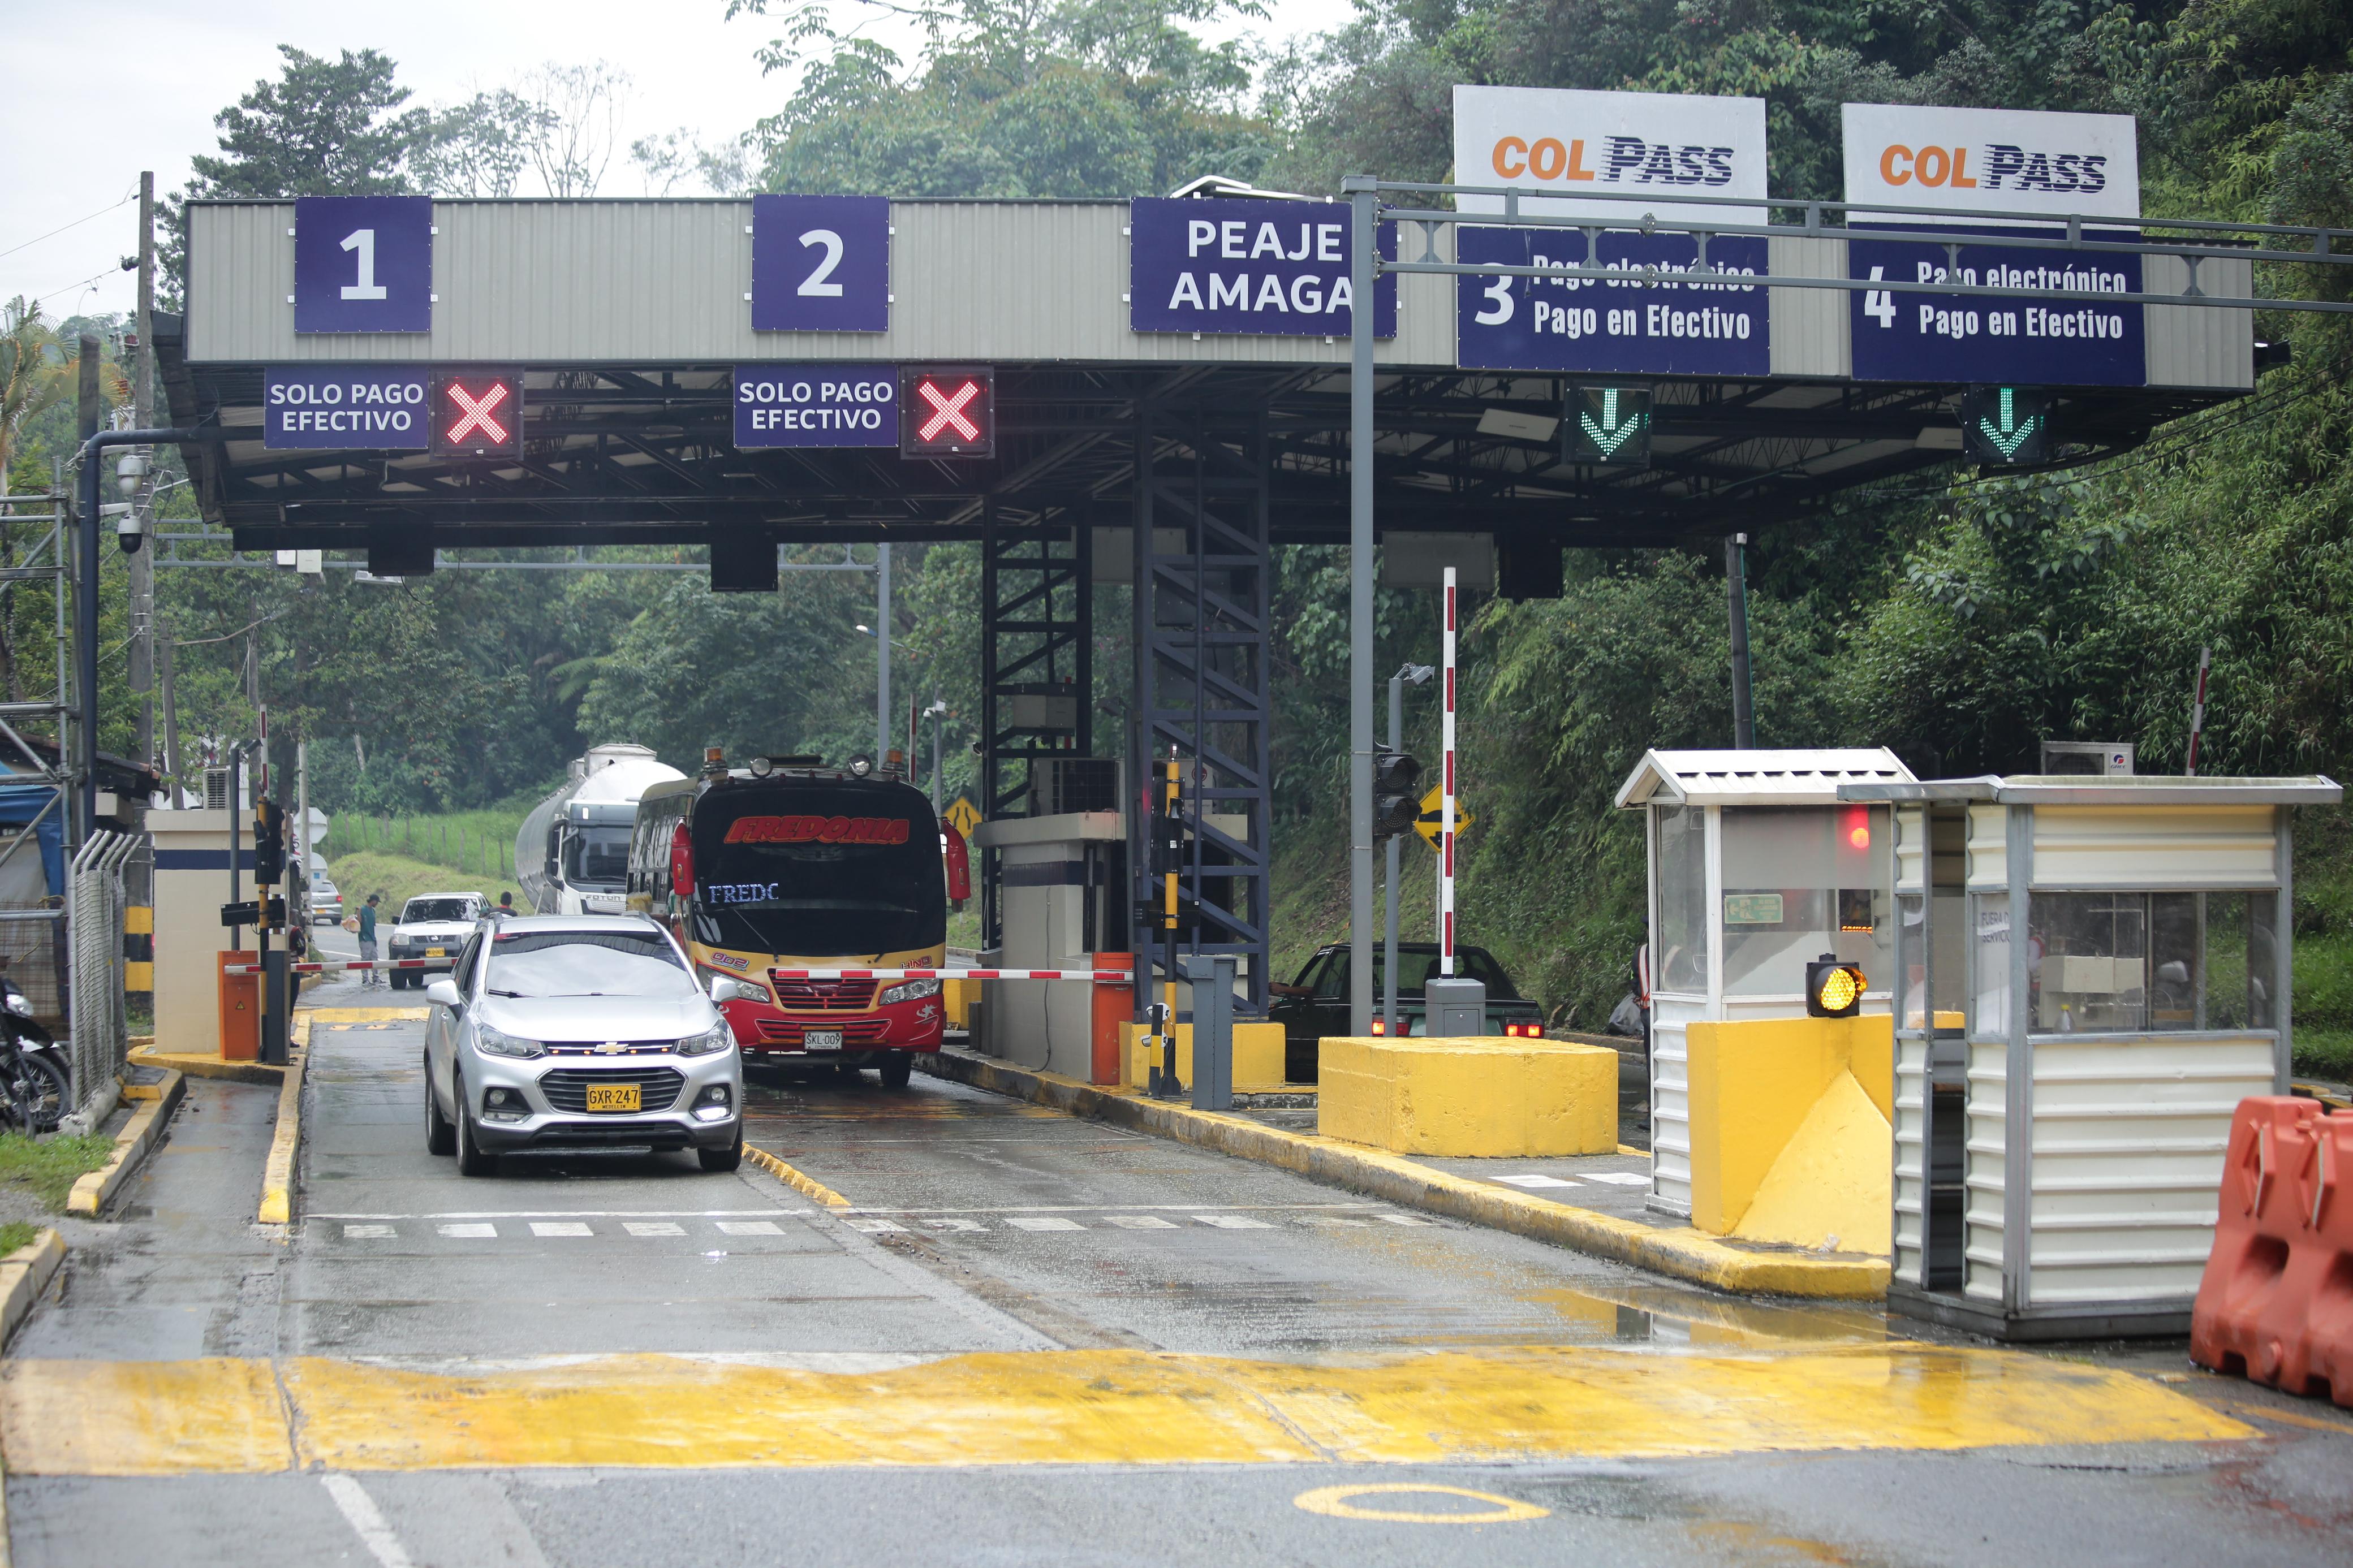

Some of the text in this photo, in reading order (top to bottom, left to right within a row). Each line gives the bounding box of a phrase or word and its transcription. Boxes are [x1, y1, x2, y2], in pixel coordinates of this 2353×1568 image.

[1188, 220, 1342, 262] PEAJE
[339, 229, 387, 300] 1
[797, 229, 843, 297] 2
[1917, 261, 2126, 296] Pao electrónico
[1475, 262, 1514, 325] 3
[1864, 266, 1896, 328] 4
[1534, 301, 1751, 339] Pago en Efectivo
[1919, 304, 2123, 339] Pago en Efectivo
[270, 383, 424, 405] SOLO PAGO
[739, 382, 893, 403] SOLO PAGO
[283, 410, 412, 431] EFECTIVO
[752, 408, 882, 430] EFECTIVO
[726, 816, 909, 844] FREDONIA
